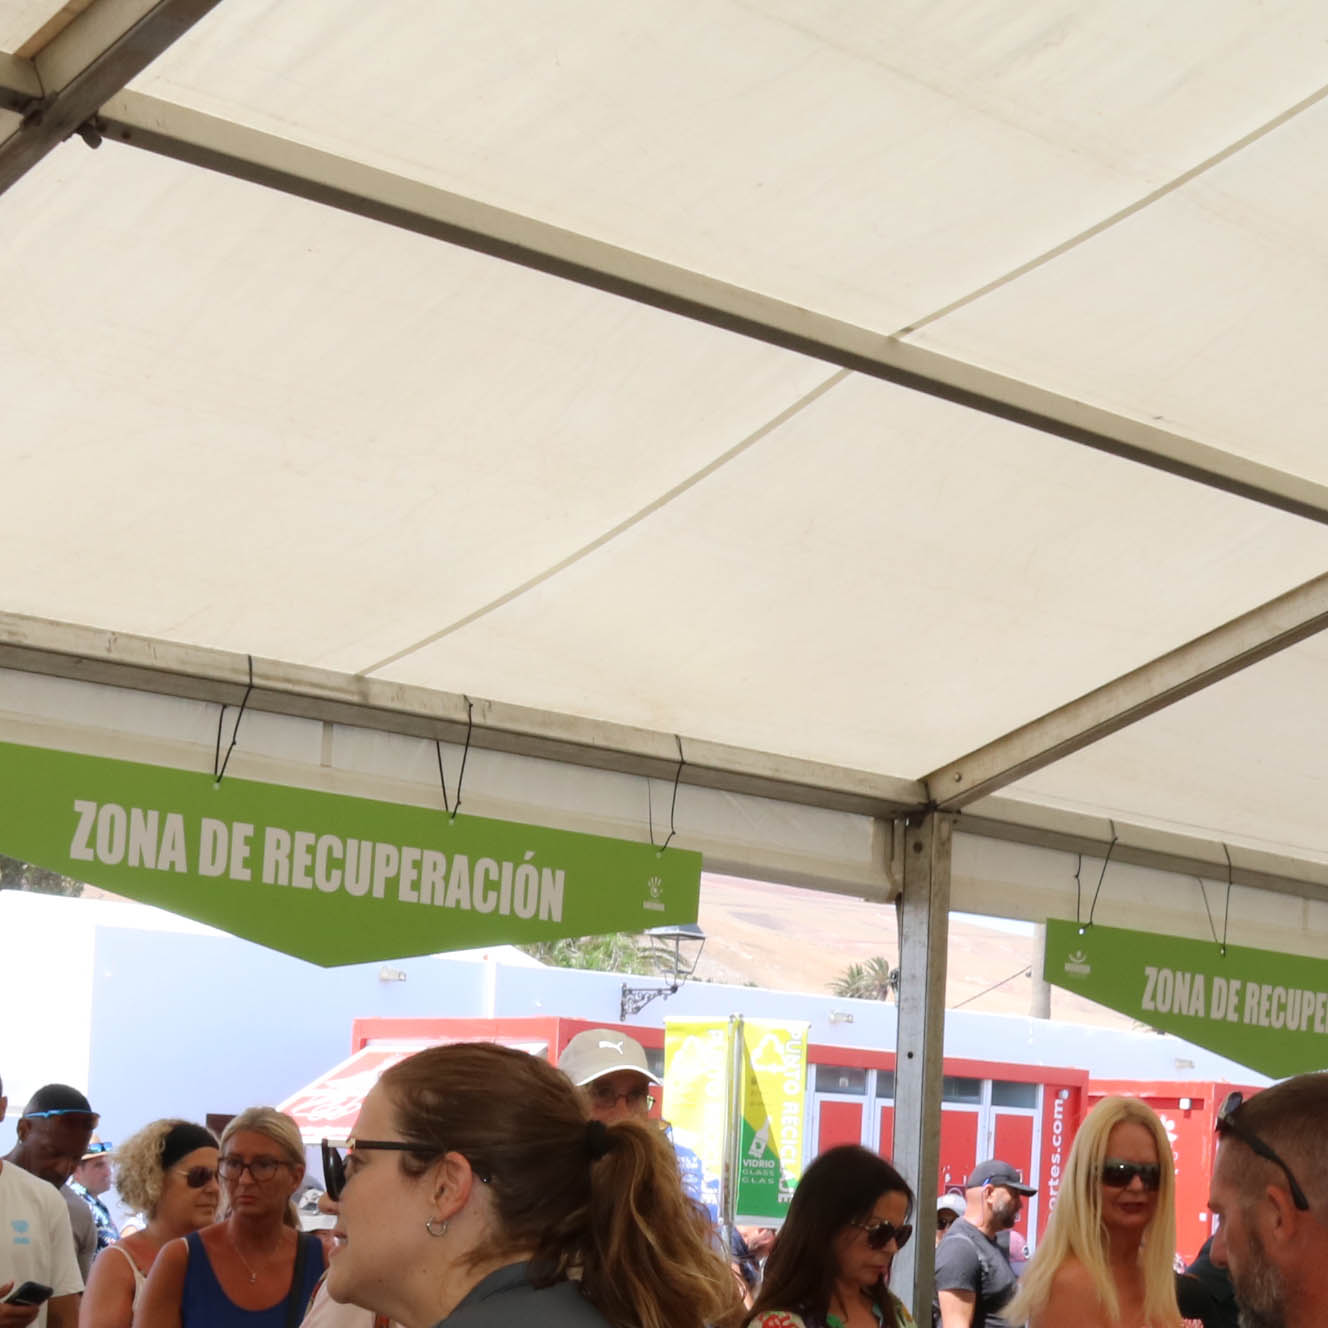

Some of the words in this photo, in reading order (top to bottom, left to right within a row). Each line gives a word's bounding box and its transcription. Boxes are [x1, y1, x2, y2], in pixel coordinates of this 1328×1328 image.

[70, 800, 188, 873] ZONA
[198, 817, 255, 881] DE
[262, 826, 566, 923] RECUPERACIÓN
[1141, 966, 1205, 1018] ZONA
[1210, 977, 1242, 1022] DE
[743, 1159, 776, 1169] VIDRIO
